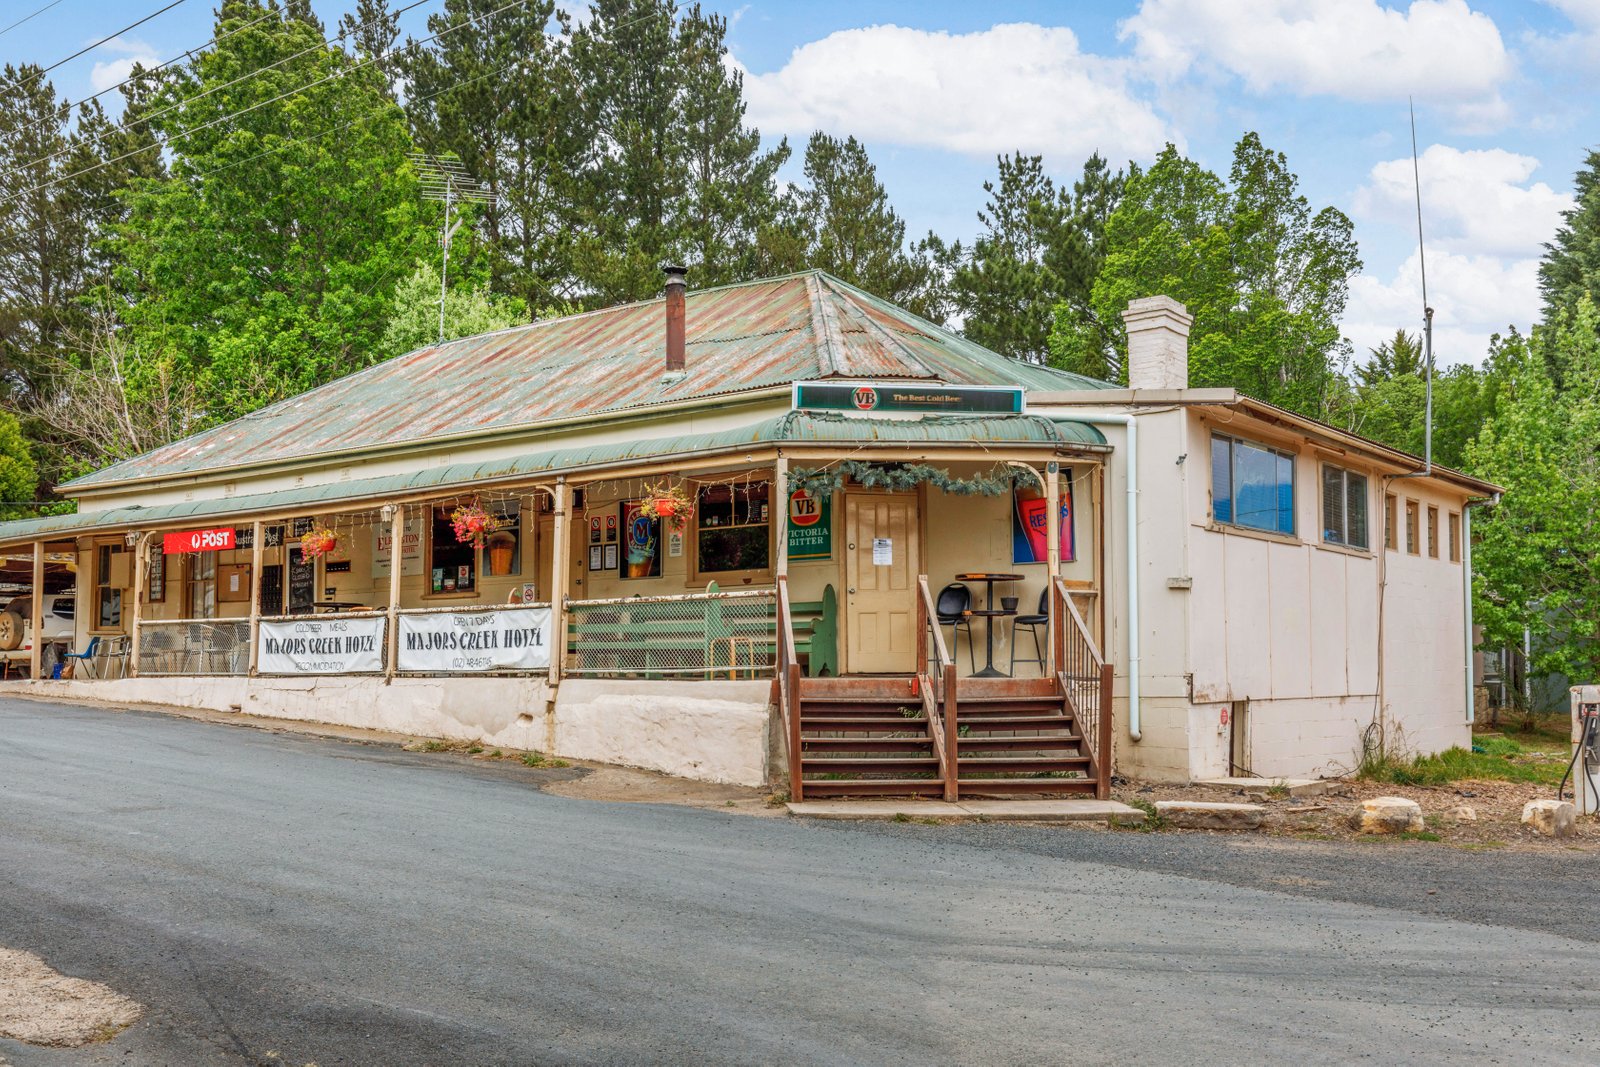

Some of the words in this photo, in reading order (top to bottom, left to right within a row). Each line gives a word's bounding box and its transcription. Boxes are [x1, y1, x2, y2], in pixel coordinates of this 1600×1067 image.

[854, 391, 876, 404] VB
[794, 498, 816, 515] VB
[202, 531, 230, 547] POST
[789, 537, 824, 547] BITTER
[475, 614, 496, 626] DAYS
[265, 637, 306, 655] MAJORS
[309, 636, 342, 655] CREEK
[345, 635, 375, 653] HOTEL
[406, 631, 457, 650] MAJORS
[459, 630, 499, 650] CREEK
[504, 628, 543, 648] HOTEL
[295, 661, 346, 671] ACCOMMODATION
